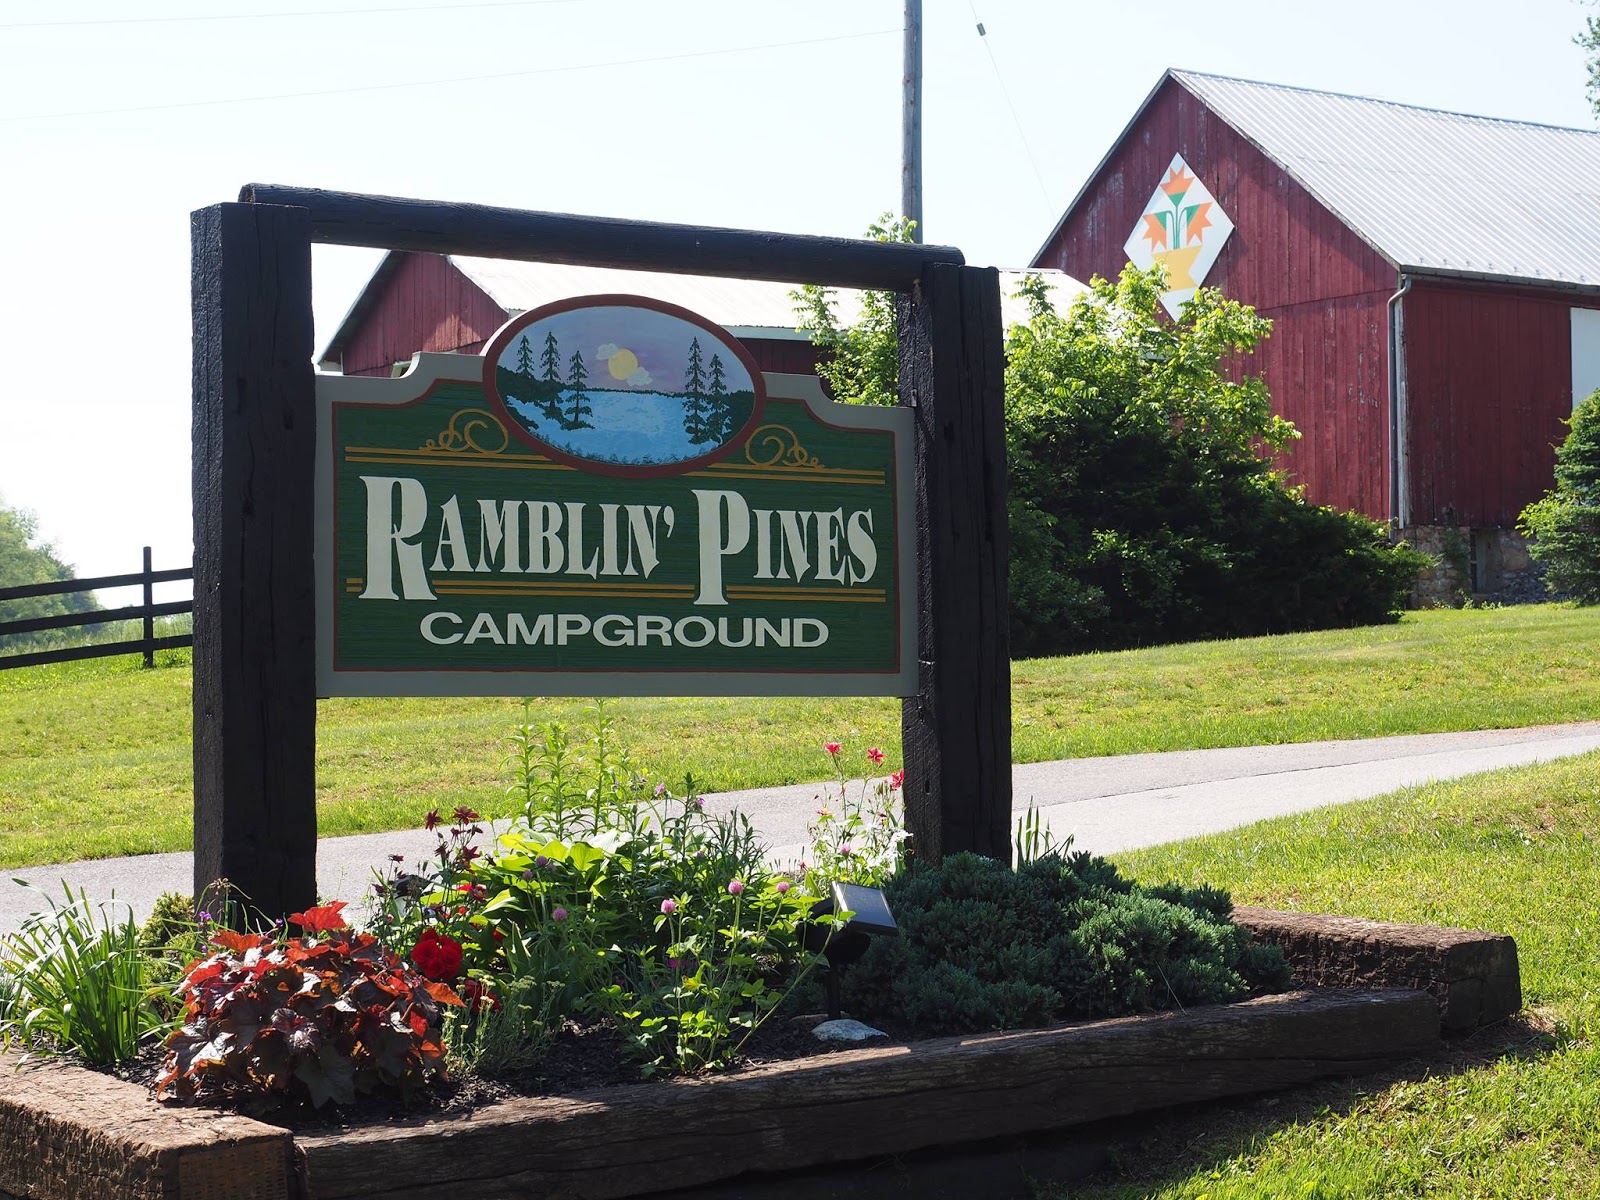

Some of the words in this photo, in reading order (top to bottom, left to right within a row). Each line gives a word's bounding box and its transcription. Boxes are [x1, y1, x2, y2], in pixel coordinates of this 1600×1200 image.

[358, 475, 675, 601] RAMBLIN'
[691, 489, 877, 605] PINES
[420, 611, 829, 648] CAMPGROUND
